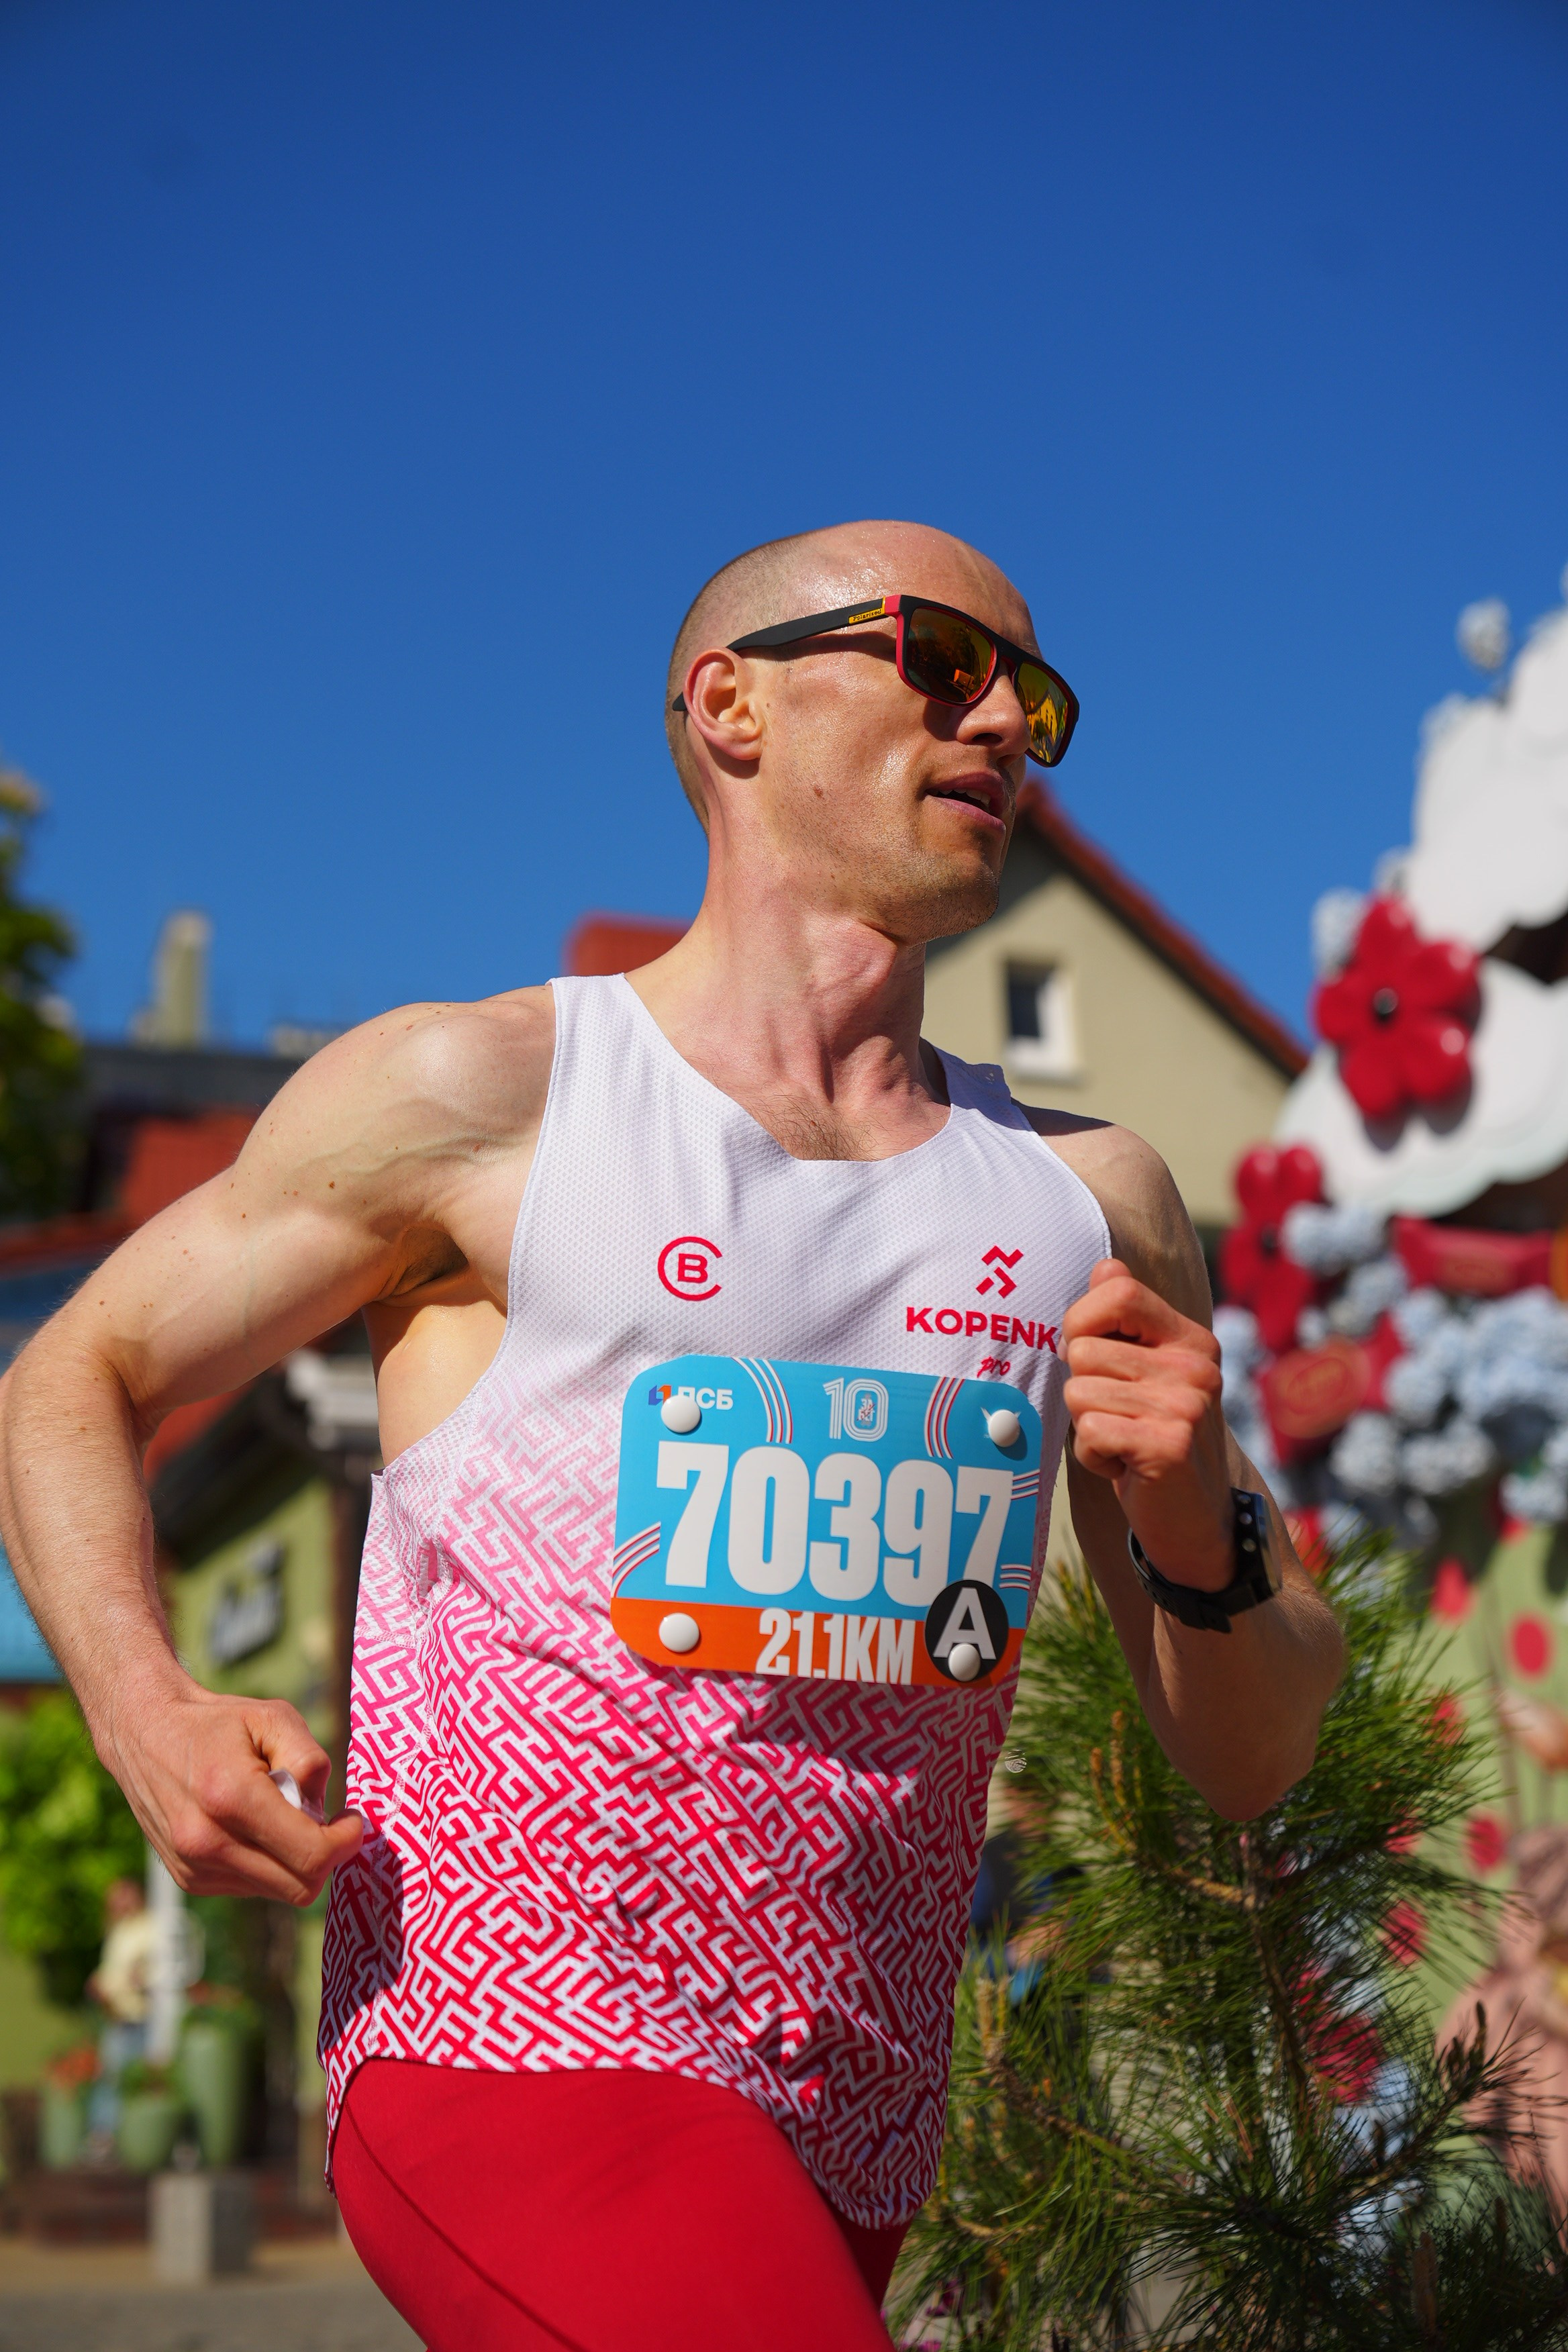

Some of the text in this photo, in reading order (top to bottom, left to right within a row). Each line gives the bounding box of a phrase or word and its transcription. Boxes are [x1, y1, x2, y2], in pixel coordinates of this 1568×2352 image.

[852, 608, 881, 622] Polarized
[906, 1307, 1062, 1354] KOPENK
[977, 1355, 1011, 1379] pro
[822, 1377, 889, 1442] 10
[656, 1440, 1014, 1607] 70397
[933, 1587, 996, 1660] A
